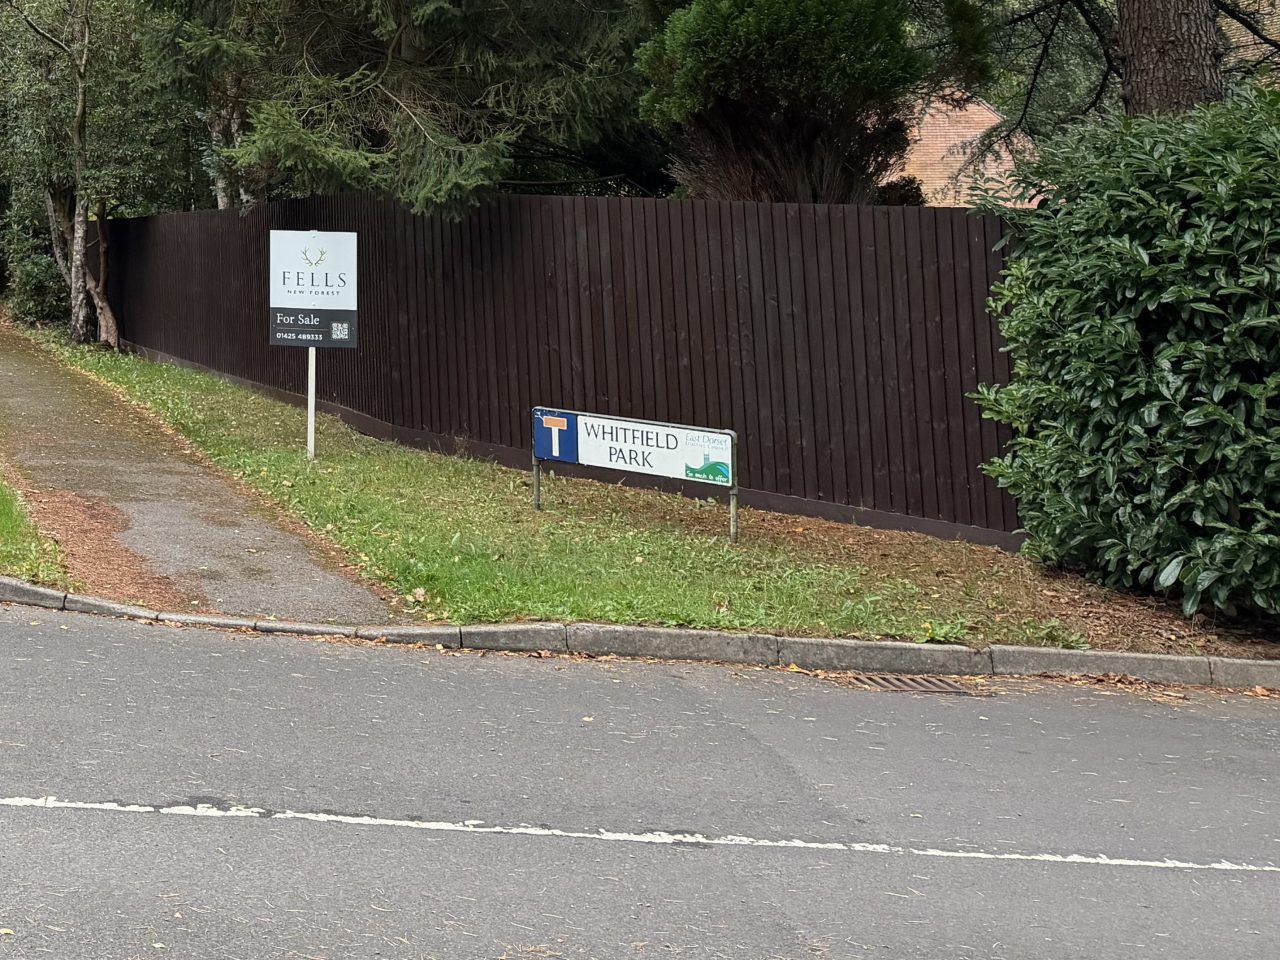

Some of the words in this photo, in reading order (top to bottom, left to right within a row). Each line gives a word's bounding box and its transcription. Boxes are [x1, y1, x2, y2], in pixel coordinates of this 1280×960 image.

[282, 271, 346, 287] FELLS
[276, 313, 295, 324] For
[298, 313, 320, 325] Sale
[584, 422, 679, 450] WHITFIELD
[608, 446, 653, 468] PARK
